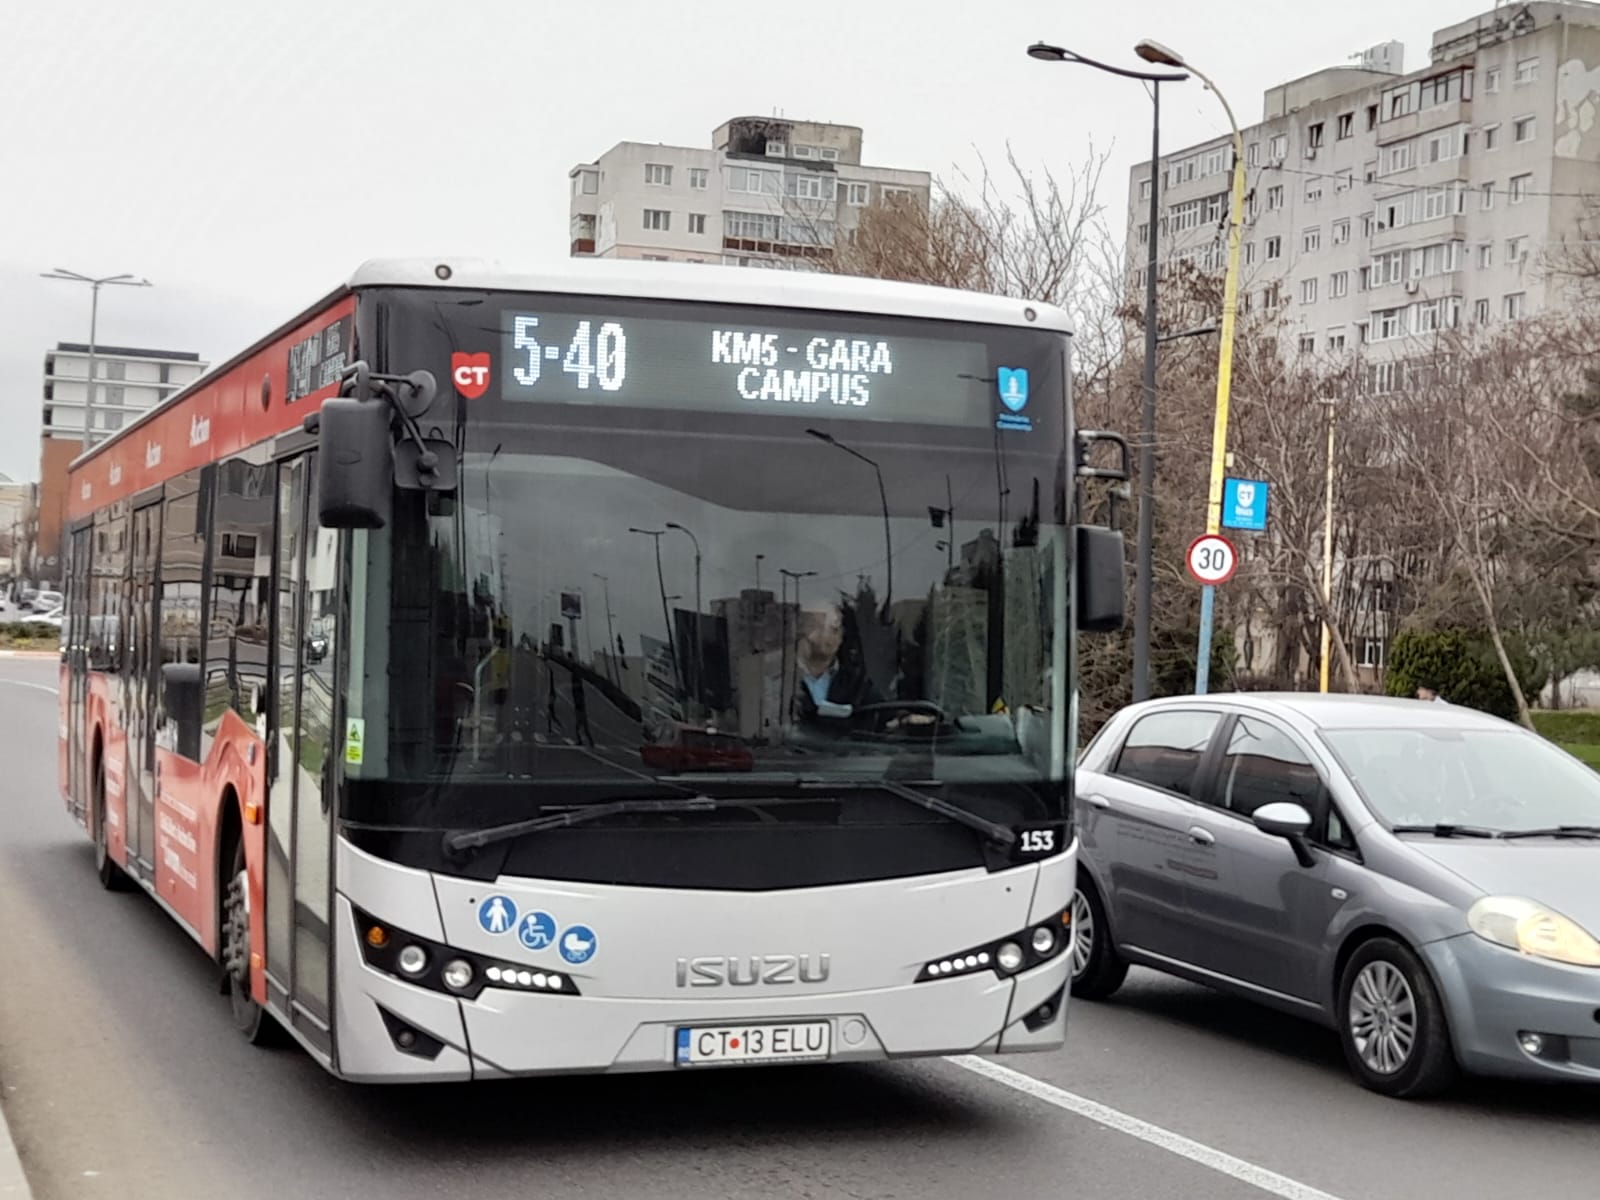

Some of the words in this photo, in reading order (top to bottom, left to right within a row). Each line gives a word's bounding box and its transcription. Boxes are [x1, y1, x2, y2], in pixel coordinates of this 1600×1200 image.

[513, 316, 626, 391] 5-40
[711, 330, 778, 366] KM5
[806, 337, 892, 374] GARA
[454, 365, 489, 386] CT
[736, 366, 870, 406] CAMPUS
[1198, 547, 1225, 571] 30
[1021, 830, 1054, 852] 153
[676, 954, 830, 987] ISUZU
[698, 1032, 731, 1056] CT
[742, 1029, 765, 1054] 13
[772, 1027, 823, 1052] ELU
